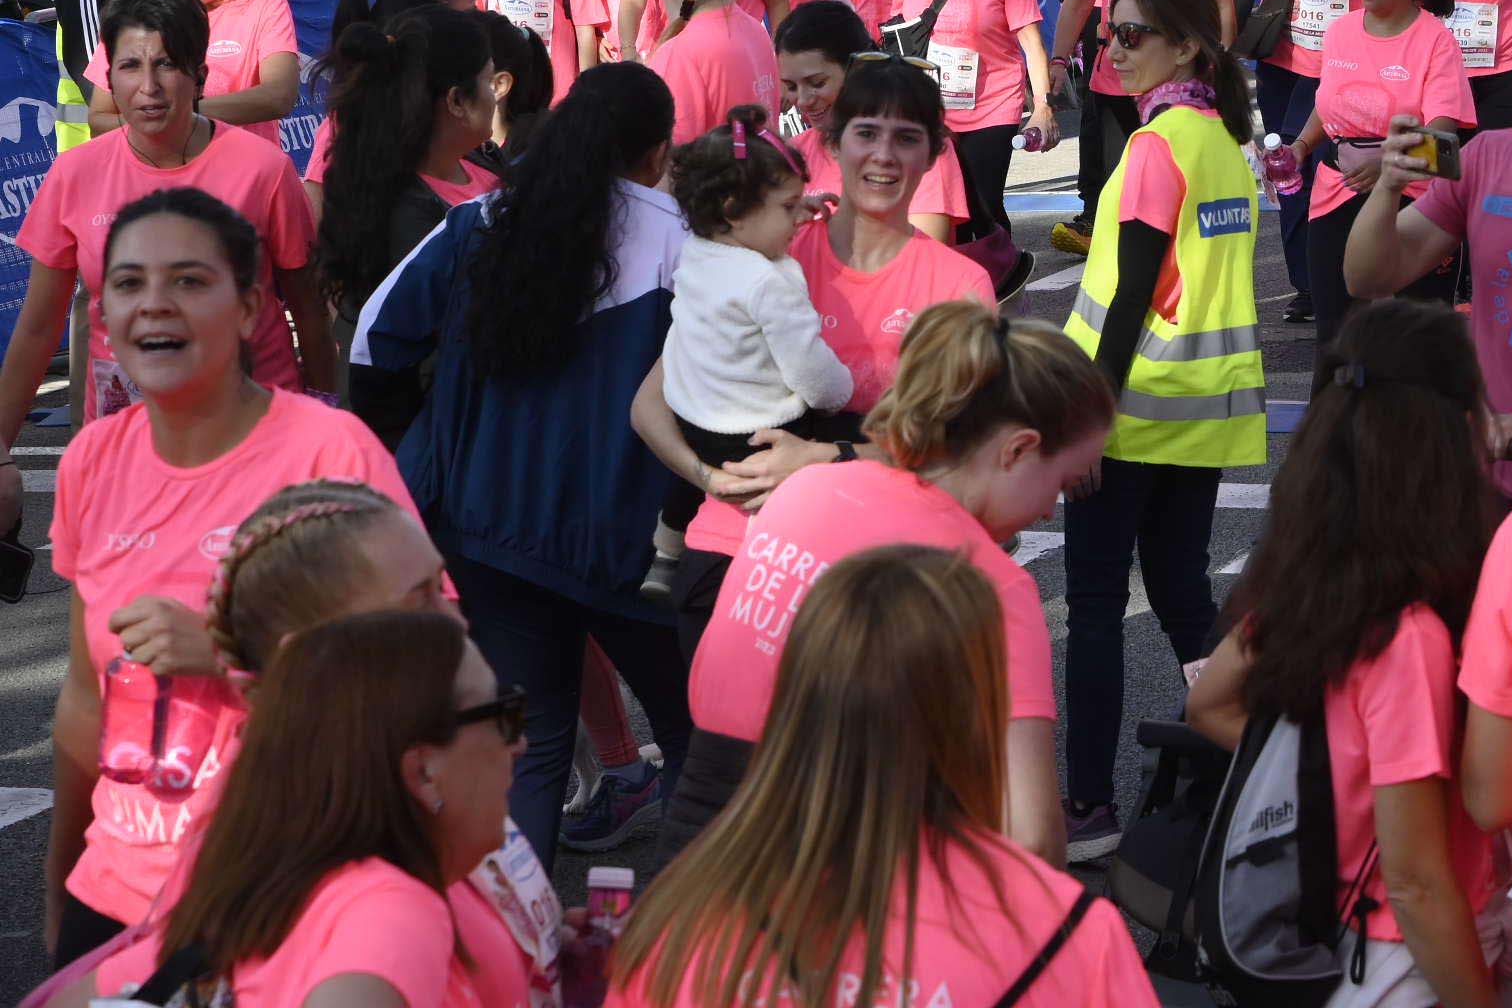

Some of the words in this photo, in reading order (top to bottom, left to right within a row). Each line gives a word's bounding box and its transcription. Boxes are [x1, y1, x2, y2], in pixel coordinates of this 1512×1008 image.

[1300, 10, 1324, 22] 016
[745, 563, 787, 601] DE
[728, 591, 789, 638] MUJ
